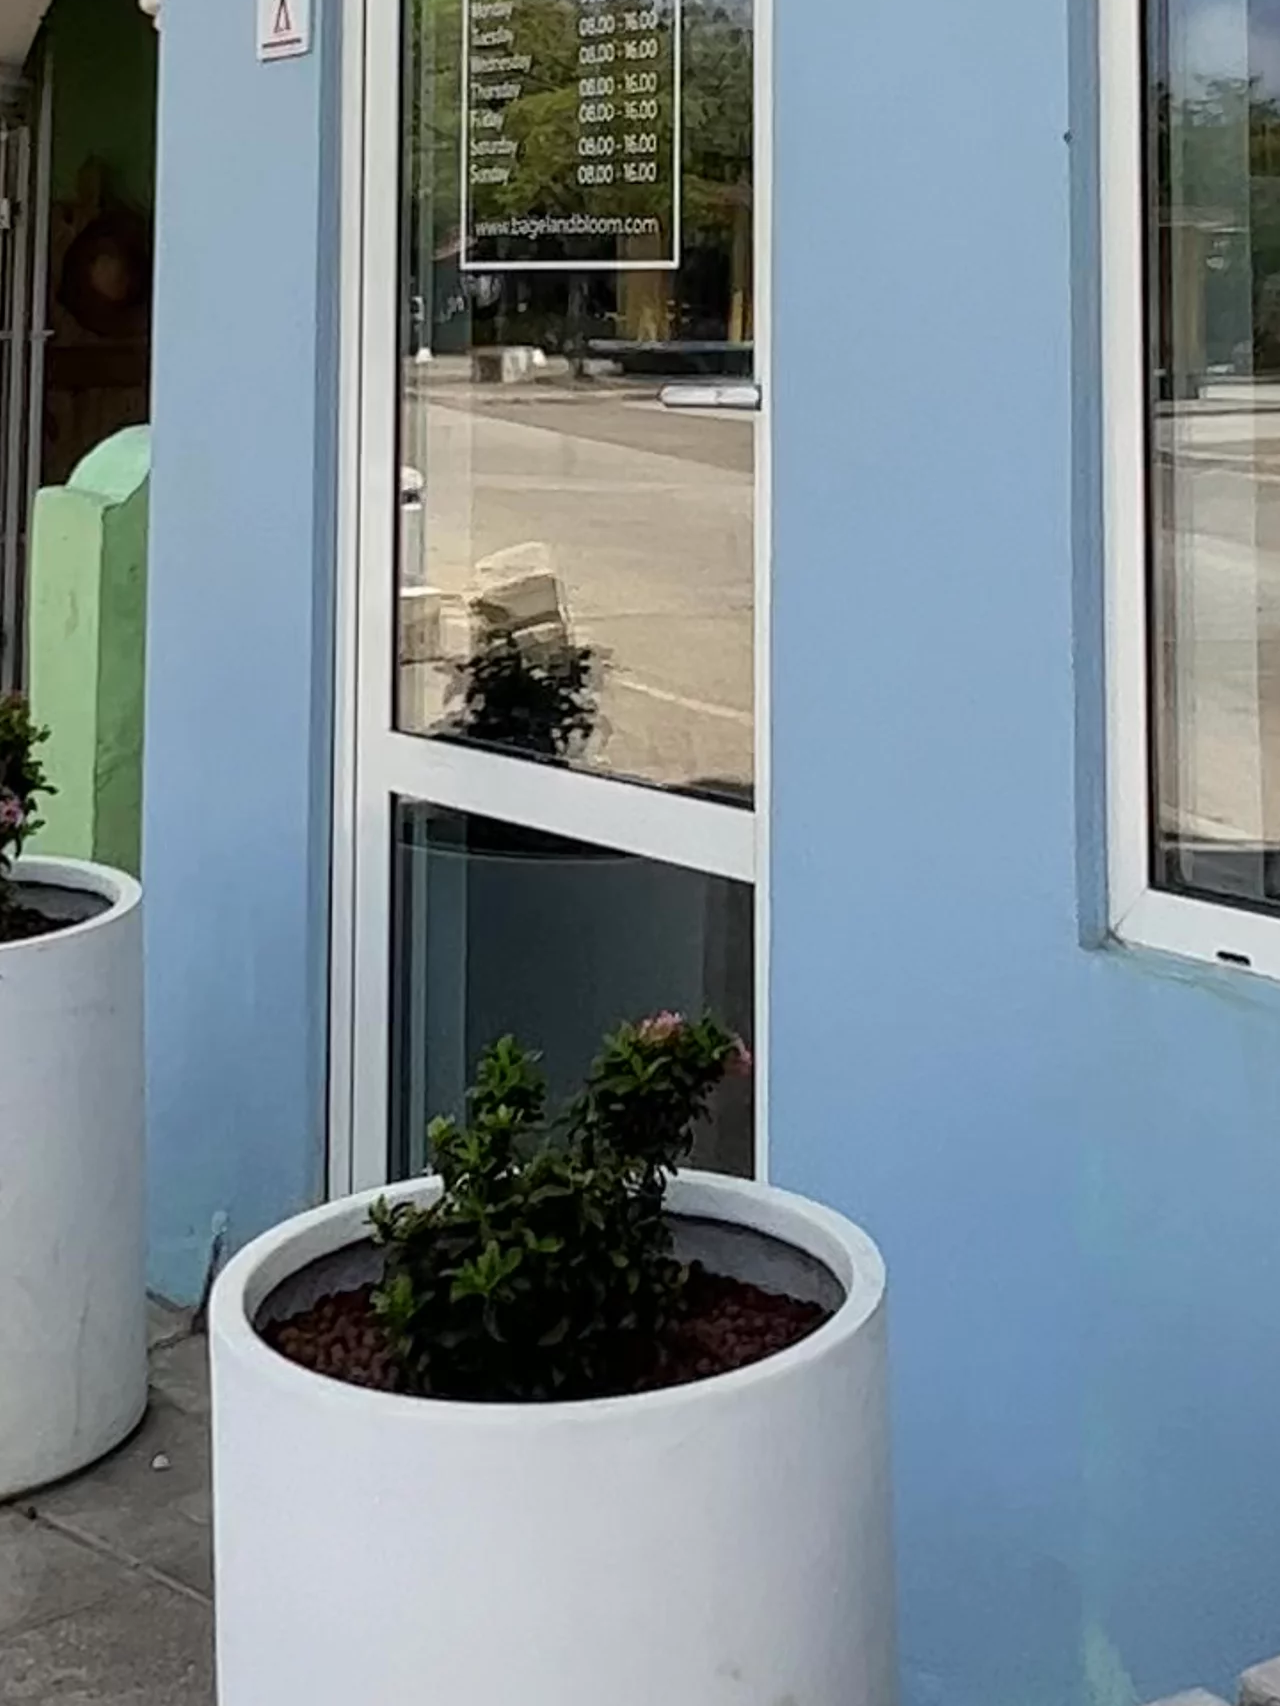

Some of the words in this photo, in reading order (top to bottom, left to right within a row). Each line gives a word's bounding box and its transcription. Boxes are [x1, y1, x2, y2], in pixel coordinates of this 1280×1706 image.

[578, 103, 615, 124] 08.00
[623, 99, 658, 120] 16.00
[578, 135, 615, 156] 08.00
[623, 133, 657, 154] 16.00
